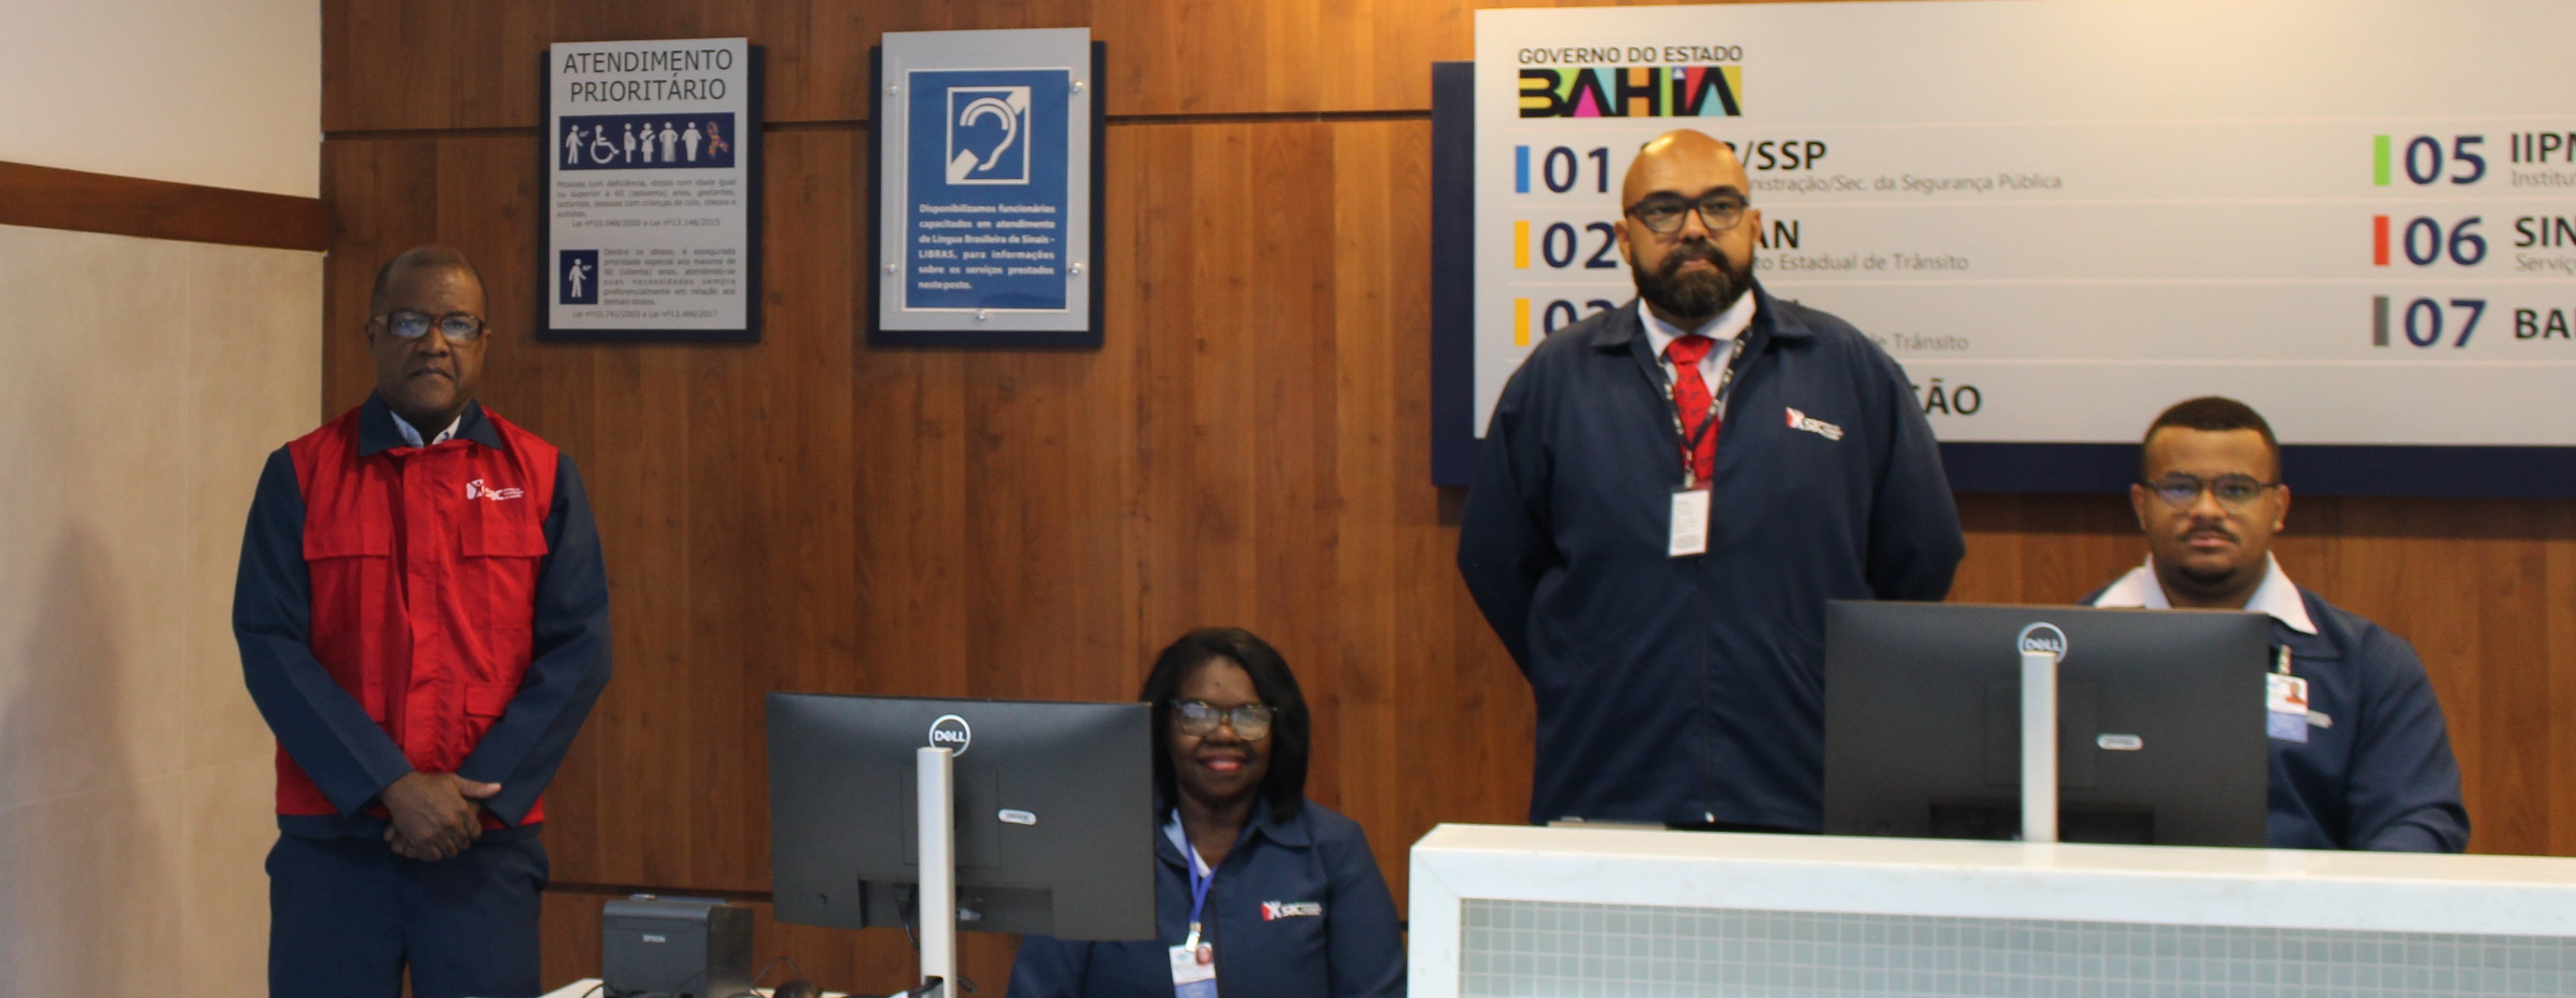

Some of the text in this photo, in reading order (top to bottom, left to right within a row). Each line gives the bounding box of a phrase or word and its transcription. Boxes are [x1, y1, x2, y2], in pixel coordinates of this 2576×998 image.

[563, 49, 732, 73] ATENDIMENTO
[1519, 45, 1743, 63] GOVERNO DO ESTADO
[570, 73, 725, 102] PRIORITÁRIO
[1519, 67, 1741, 118] BAHIA
[1543, 146, 1610, 193] 01
[2405, 135, 2486, 184] 05
[1902, 174, 1993, 195] Segurança
[2512, 170, 2576, 186] Institu
[1543, 222, 1617, 268] 02
[2404, 216, 2487, 266] 06
[1779, 252, 1857, 270] Estadual
[1863, 253, 1887, 270] de
[1893, 252, 1969, 271] Trânsito
[2405, 298, 2576, 348] 07 BA
[1893, 333, 1969, 350] Trânsito
[934, 730, 966, 742] DELL
